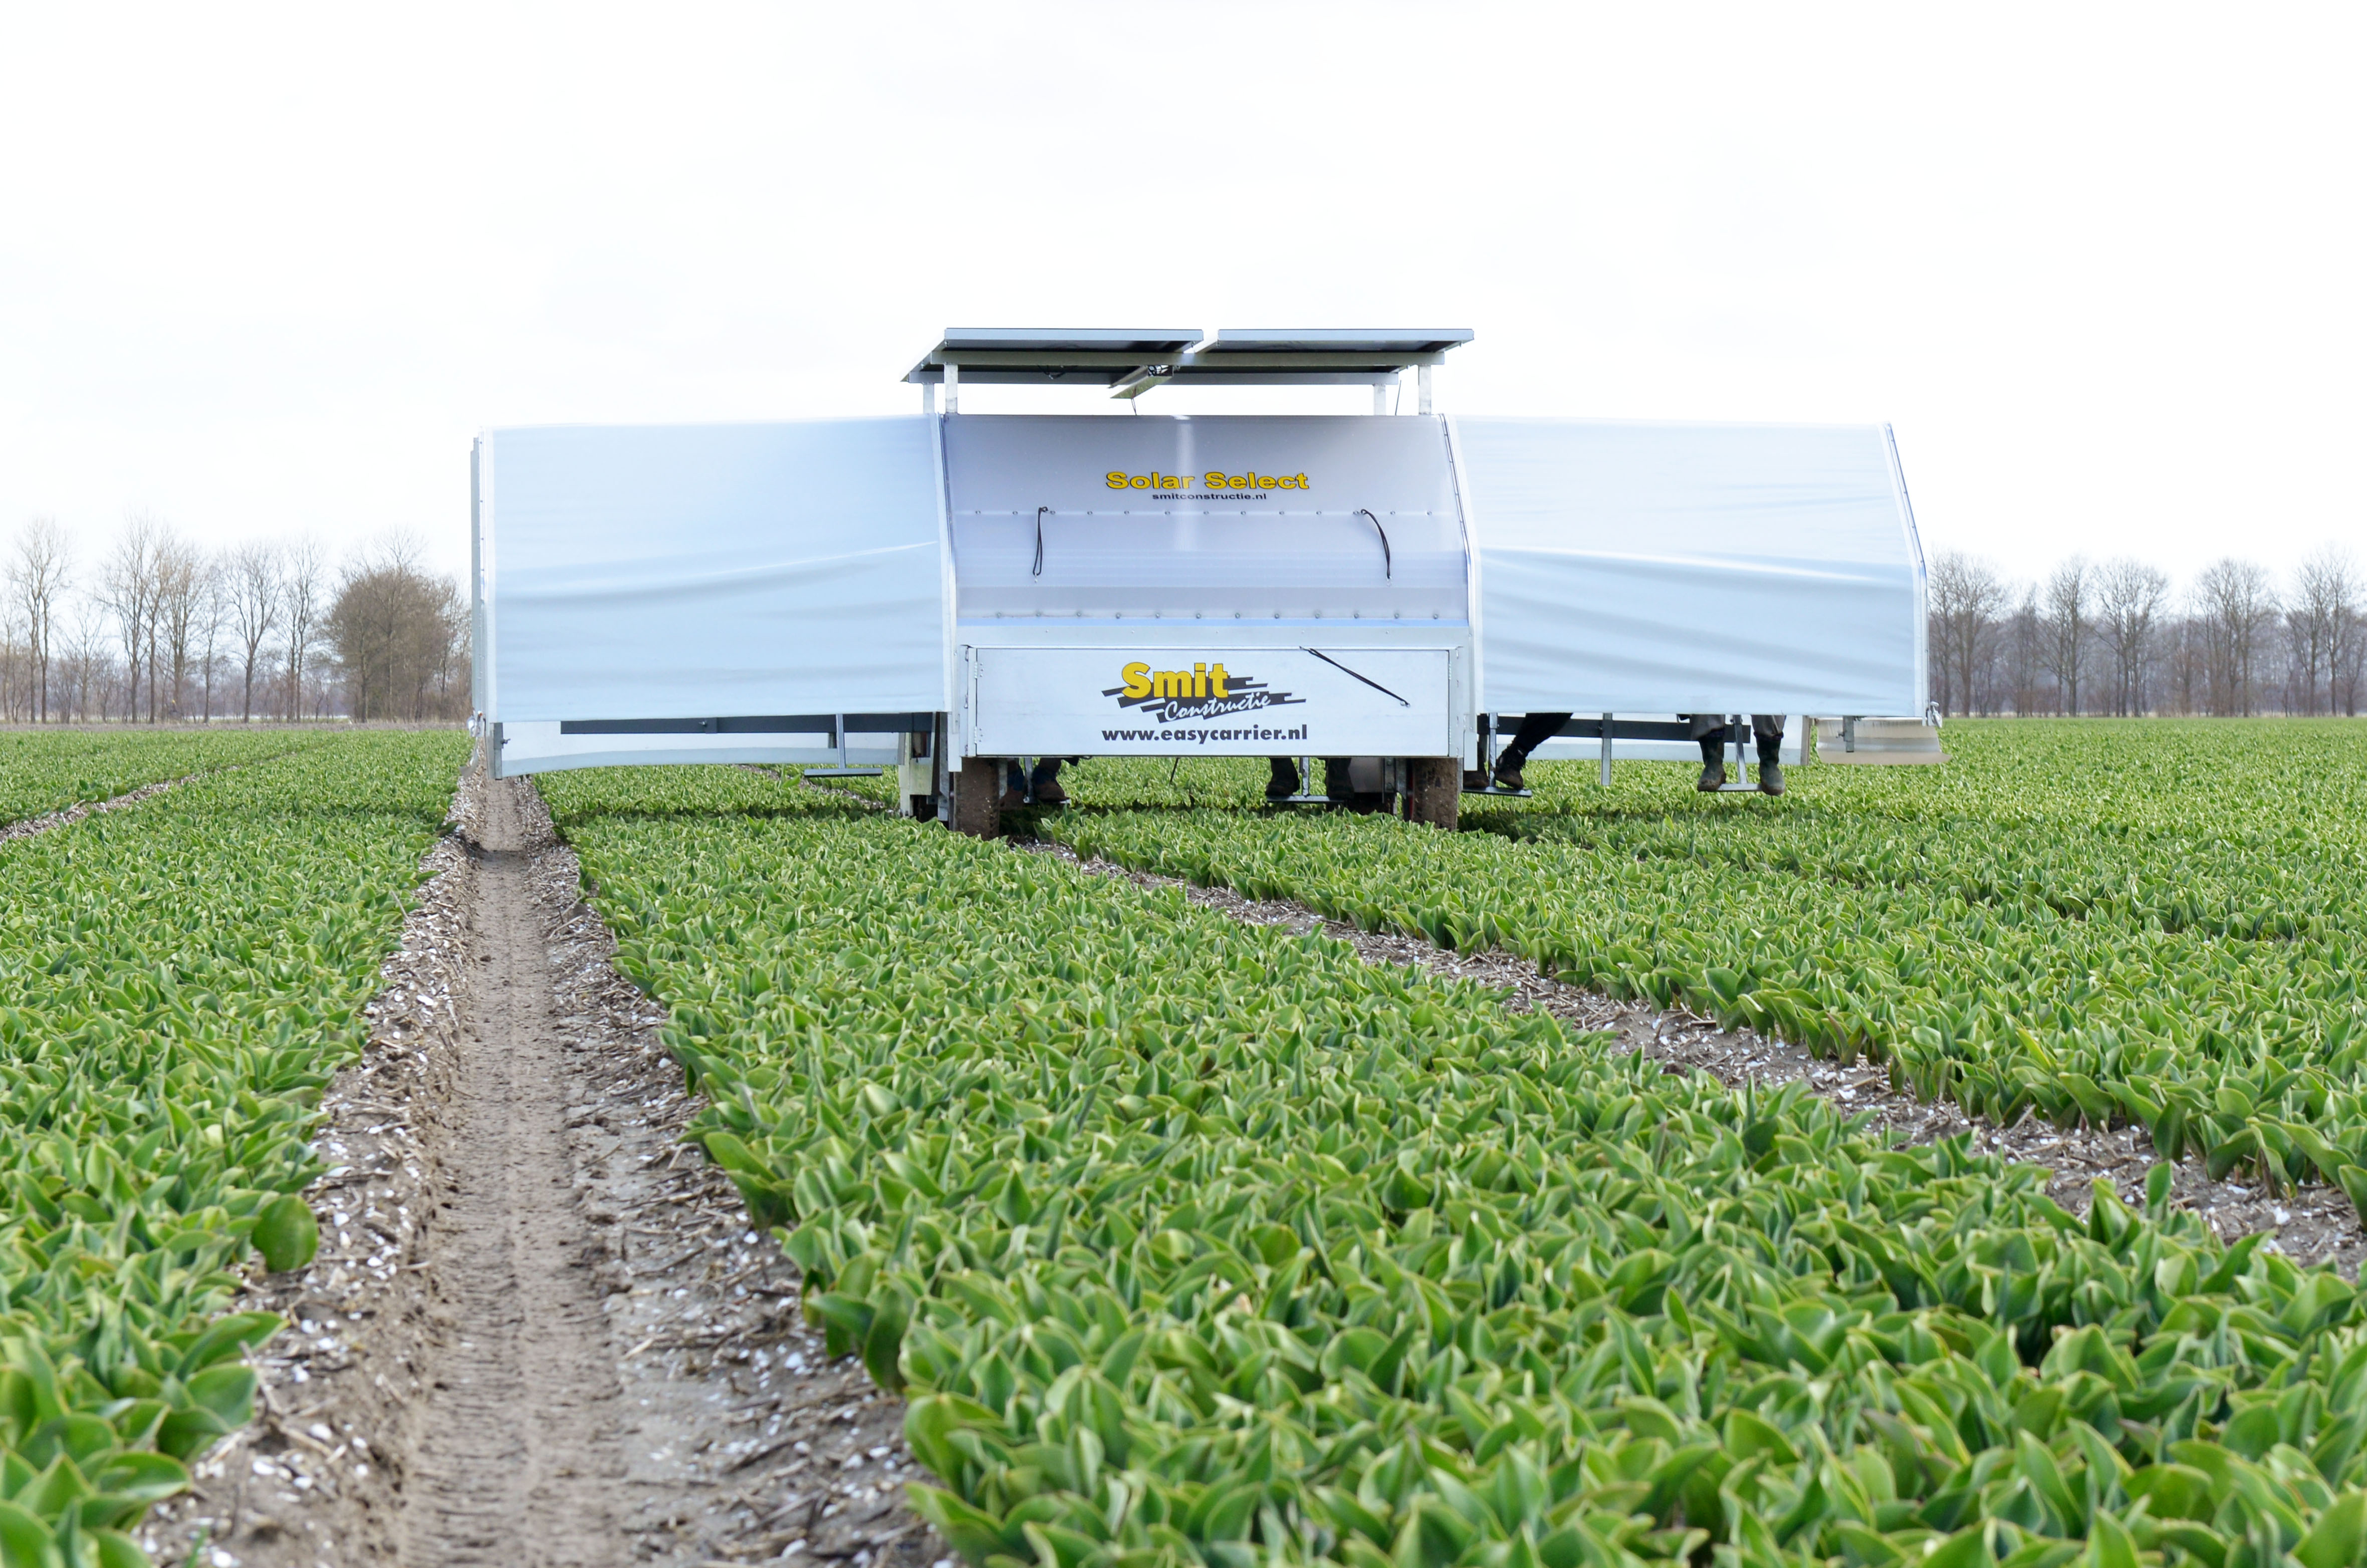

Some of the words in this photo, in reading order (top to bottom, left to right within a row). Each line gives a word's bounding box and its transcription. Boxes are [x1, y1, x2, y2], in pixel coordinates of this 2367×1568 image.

[1105, 472, 1195, 489] Solar
[1205, 472, 1309, 489] Select
[1121, 662, 1229, 698] Smit
[1164, 692, 1271, 721] Constructie
[1102, 724, 1307, 744] www.easycarrier.nl
